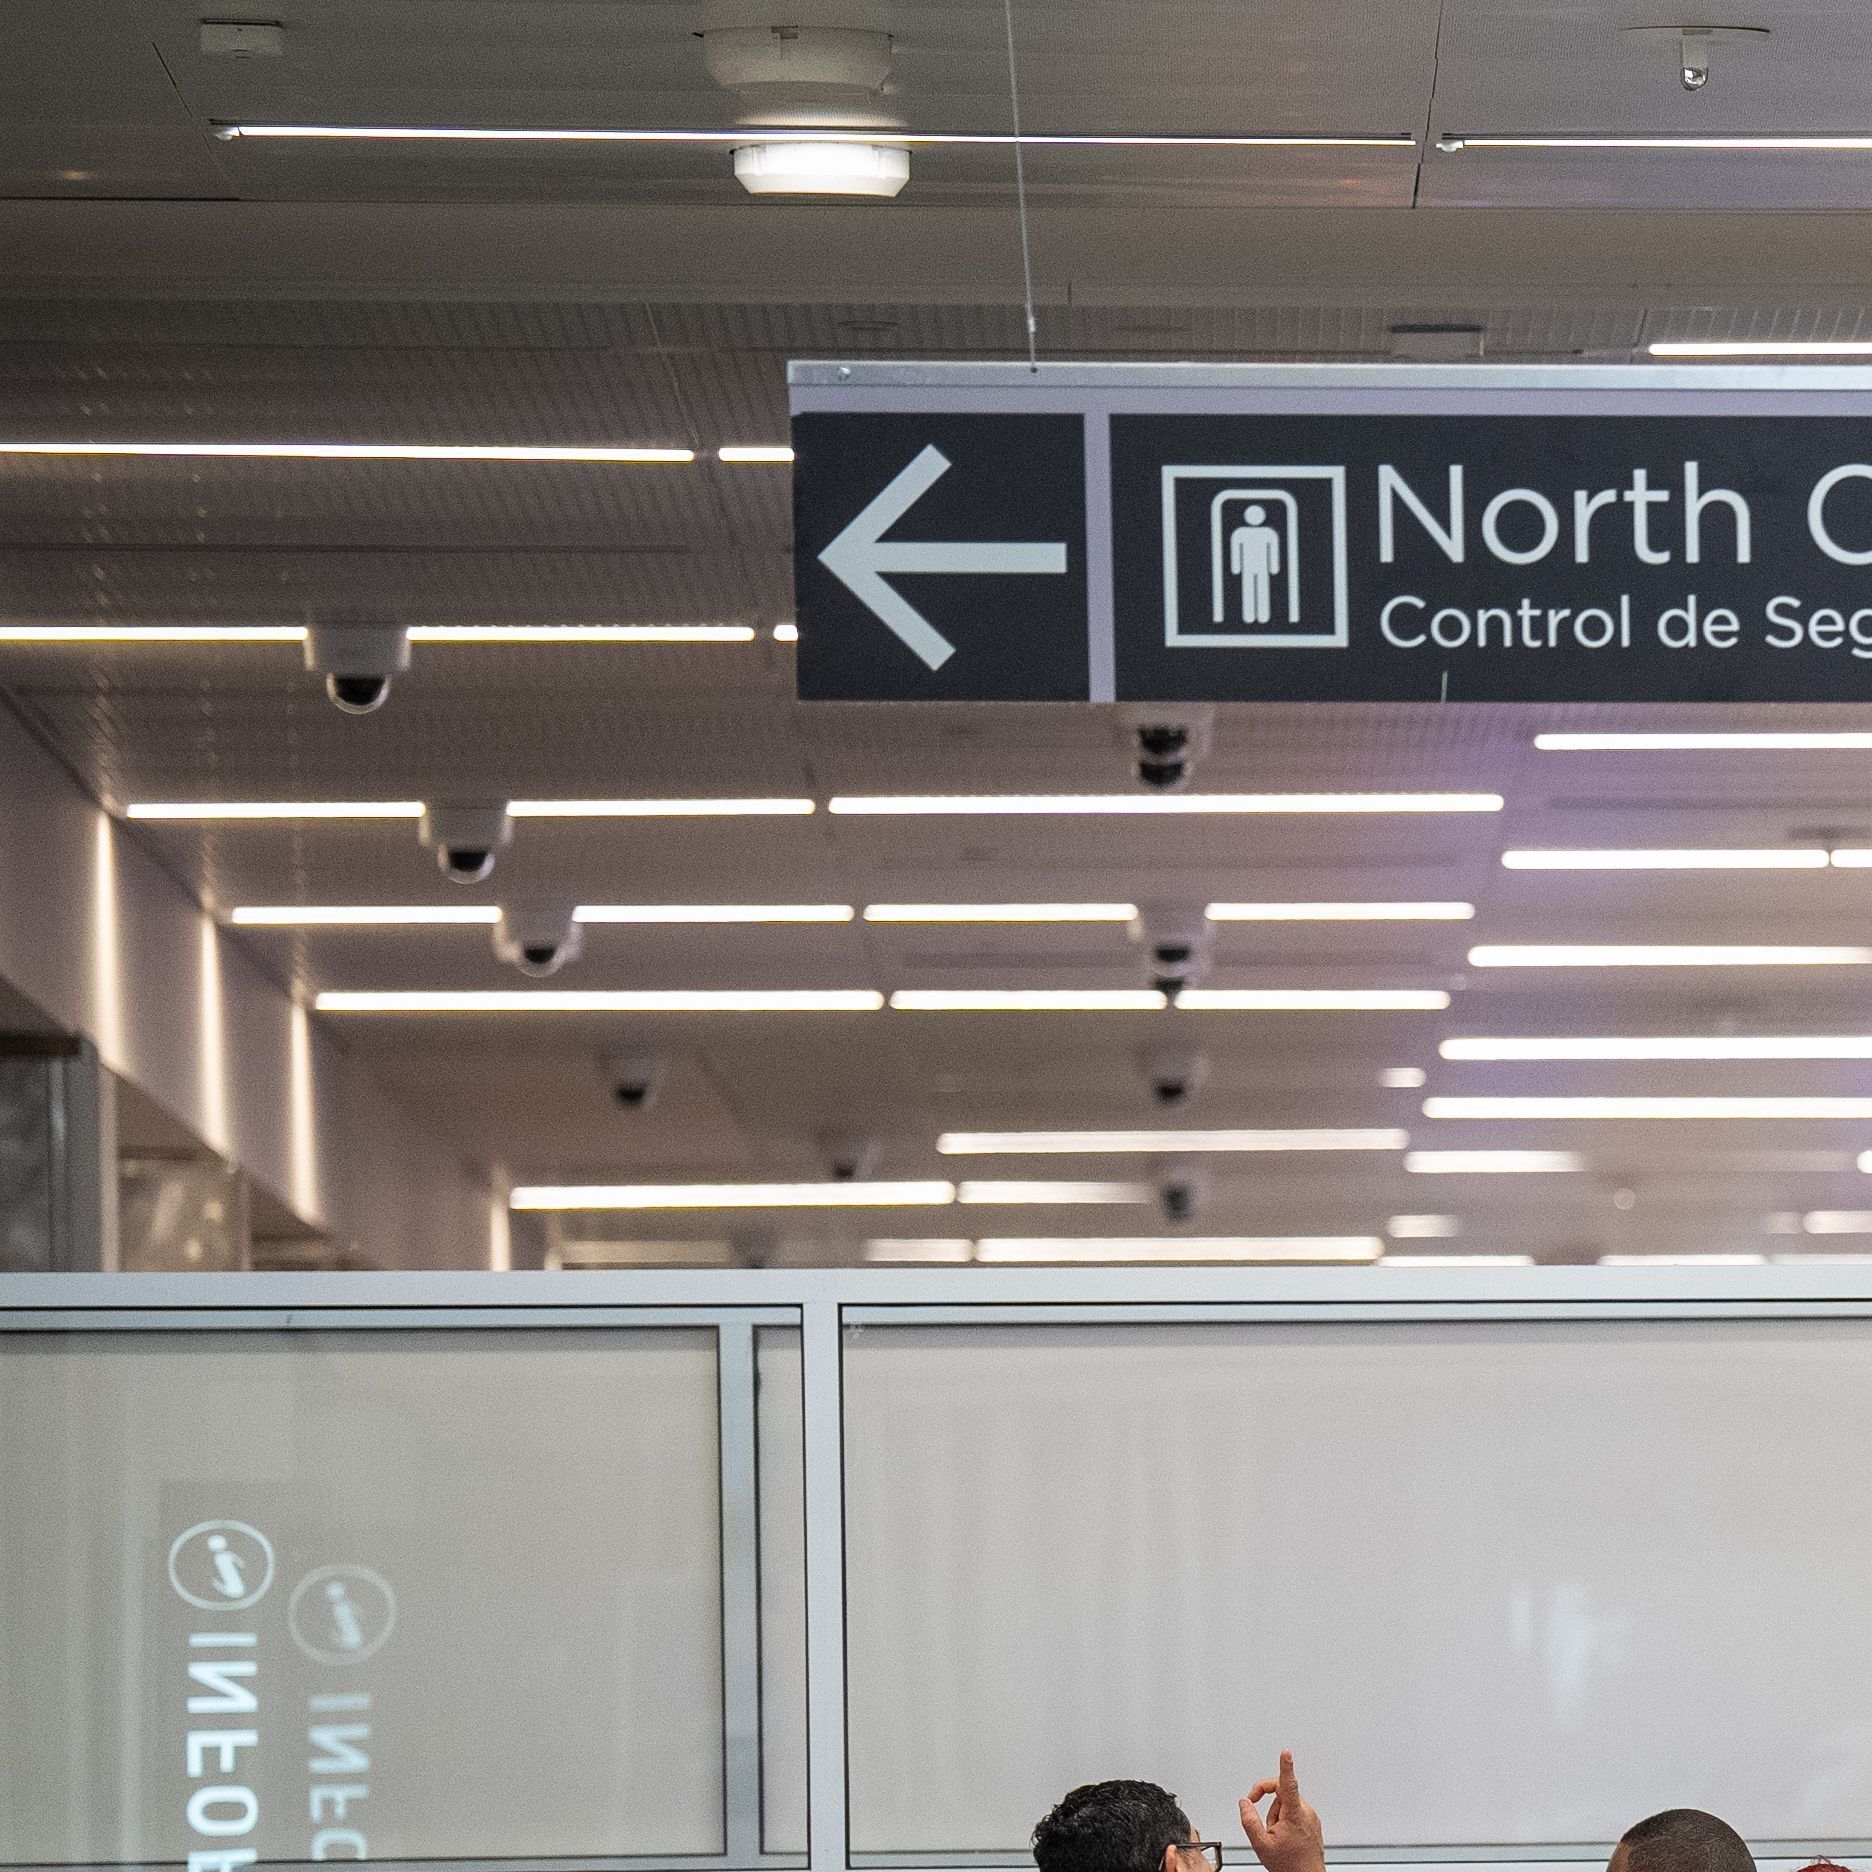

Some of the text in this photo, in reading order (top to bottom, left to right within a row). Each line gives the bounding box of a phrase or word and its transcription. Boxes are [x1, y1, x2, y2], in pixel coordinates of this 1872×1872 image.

[1378, 460, 1751, 565] North
[1380, 594, 1631, 649] Control
[1657, 594, 1740, 649] de
